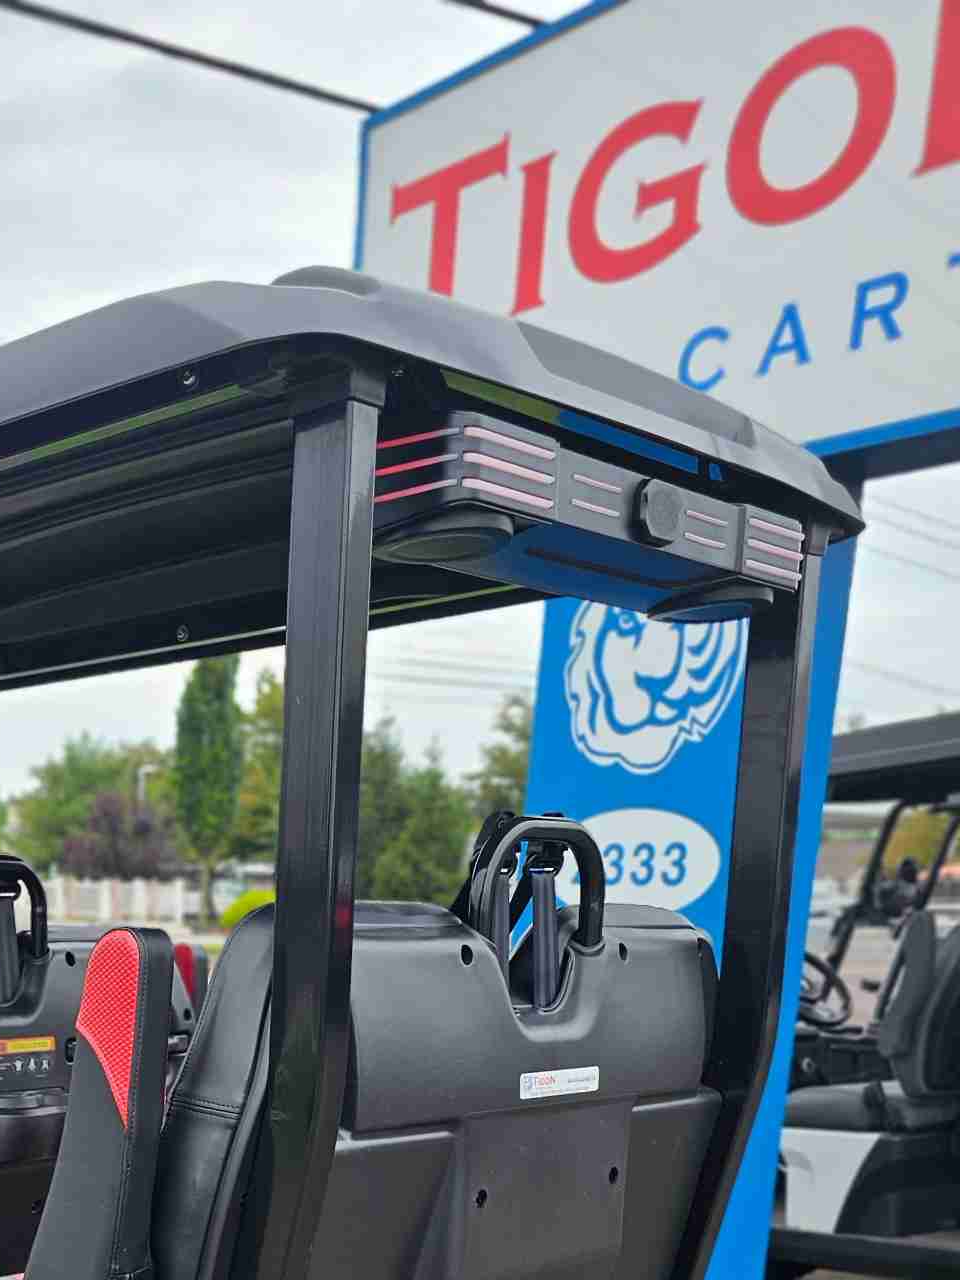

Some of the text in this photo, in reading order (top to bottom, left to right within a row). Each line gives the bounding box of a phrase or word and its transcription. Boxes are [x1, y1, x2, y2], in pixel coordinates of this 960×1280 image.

[390, 0, 960, 317] TIGO
[677, 252, 960, 391] CAR
[571, 841, 689, 887] 333
